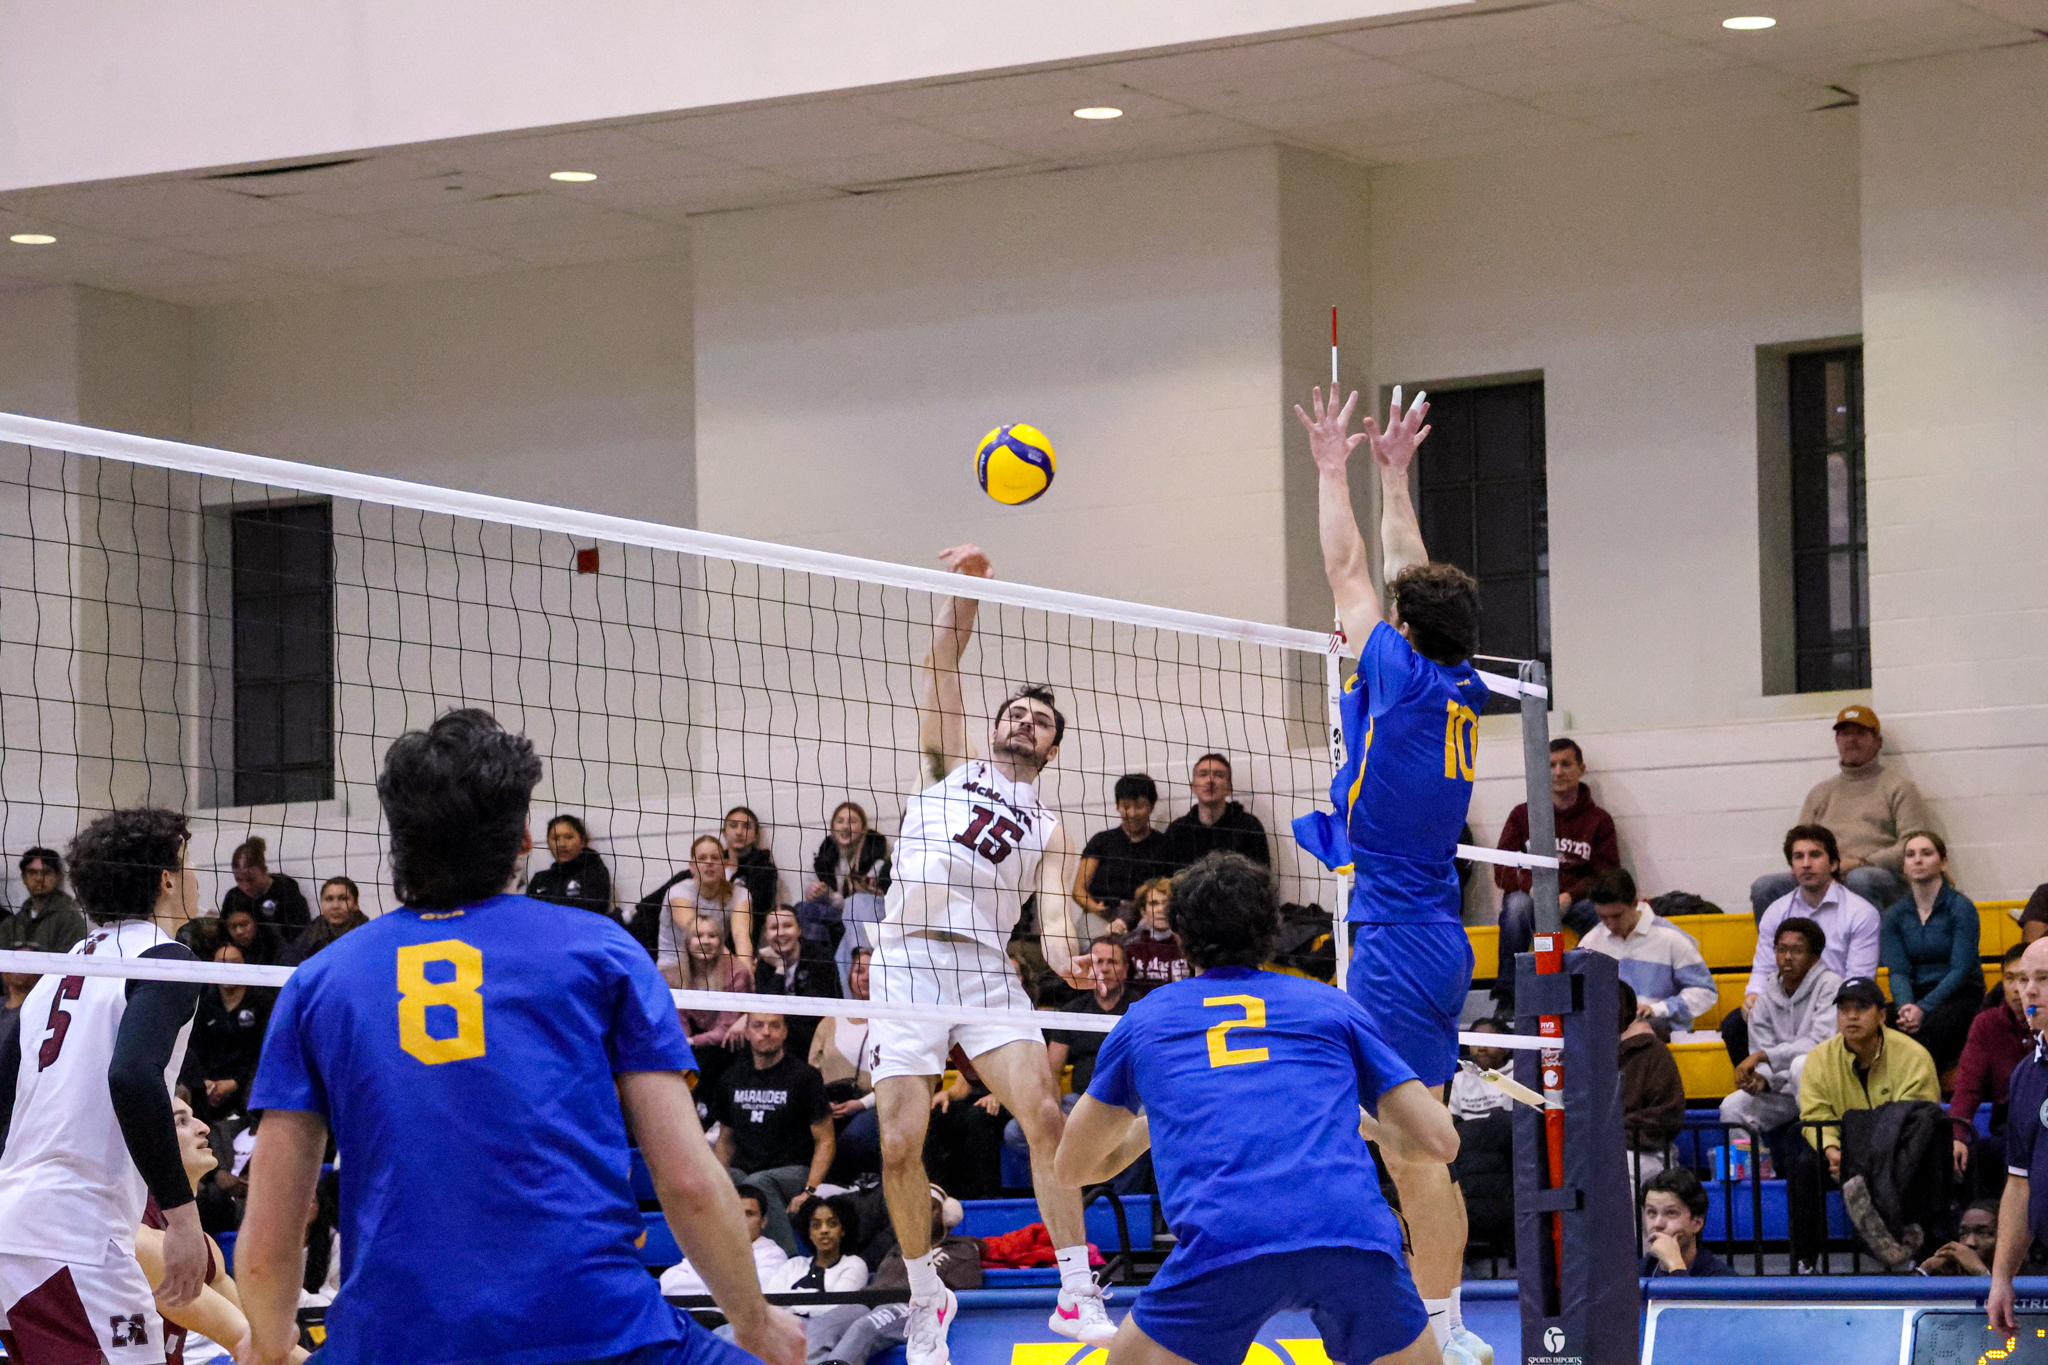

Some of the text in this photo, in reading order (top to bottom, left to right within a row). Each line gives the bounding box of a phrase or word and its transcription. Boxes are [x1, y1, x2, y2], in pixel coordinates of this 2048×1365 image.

[1444, 698, 1478, 782] 10
[952, 804, 1025, 865] 15
[38, 974, 85, 1073] 5
[397, 939, 486, 1066] 8
[1203, 994, 1270, 1068] 2
[733, 1089, 788, 1104] MARAUDER
[1527, 1356, 1583, 1365] SPORTS IMPORTS
